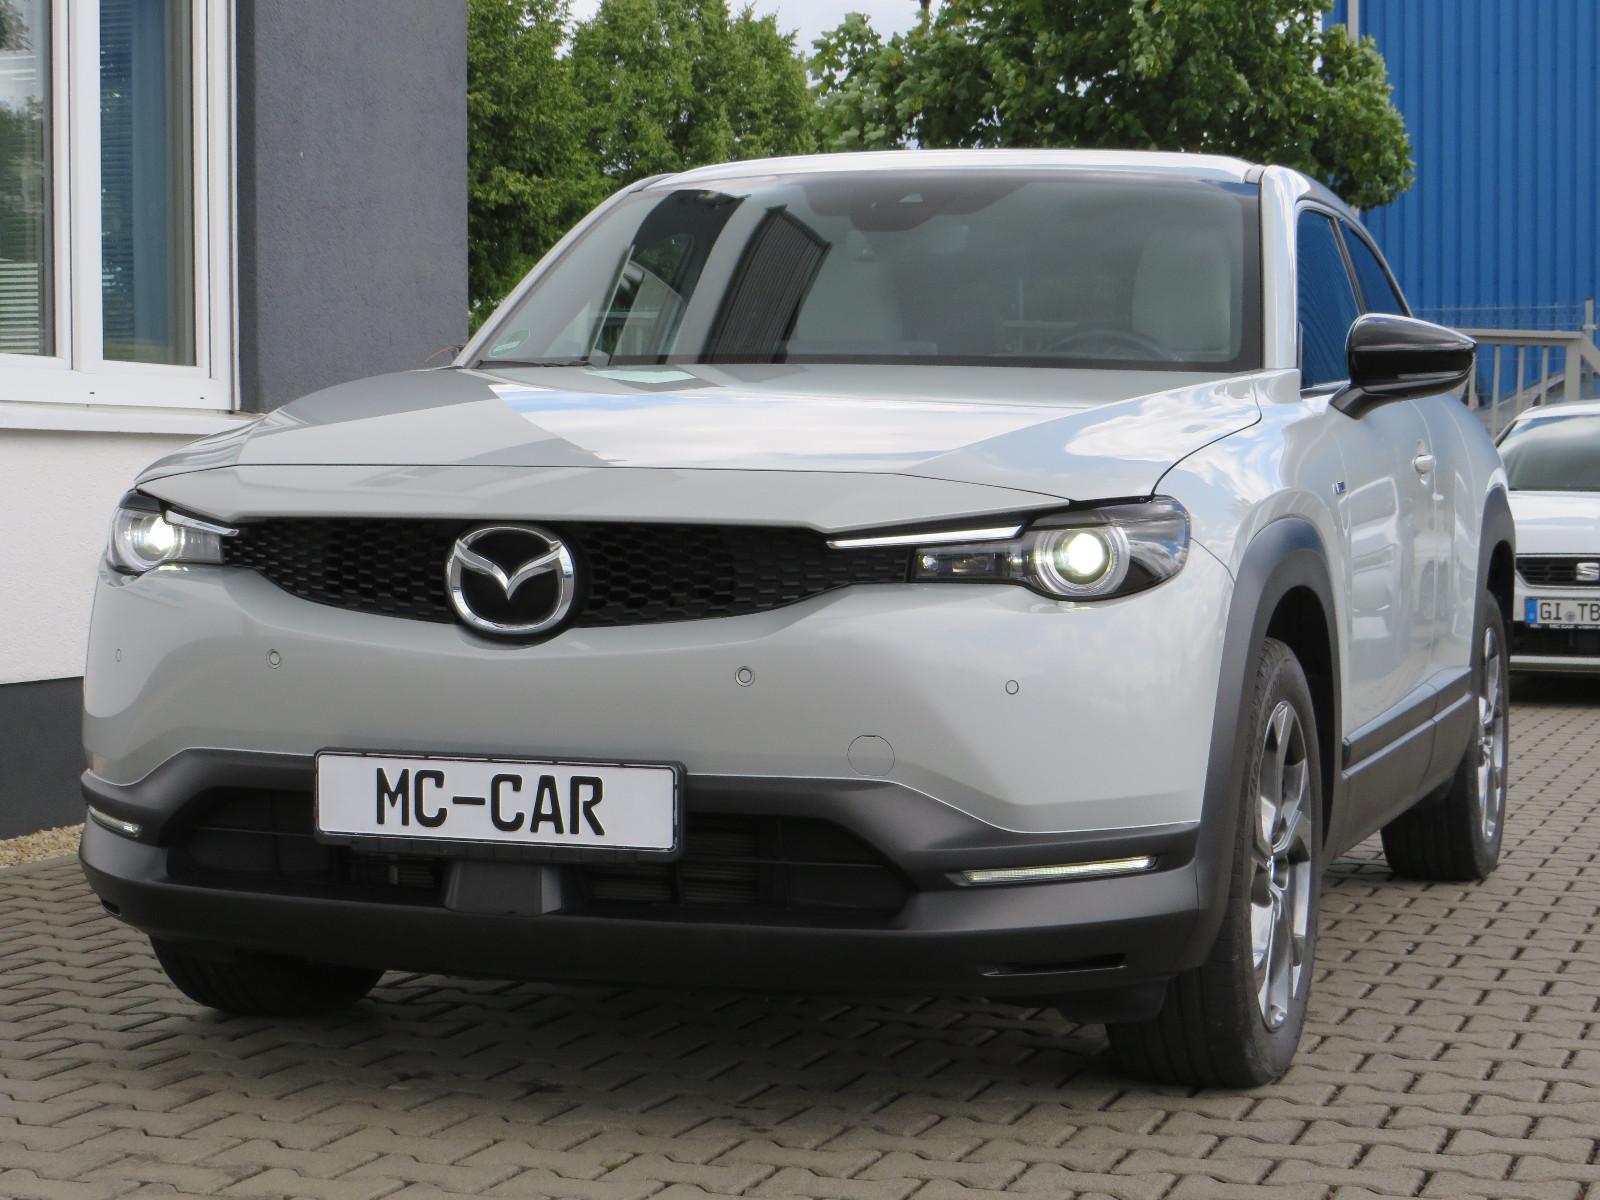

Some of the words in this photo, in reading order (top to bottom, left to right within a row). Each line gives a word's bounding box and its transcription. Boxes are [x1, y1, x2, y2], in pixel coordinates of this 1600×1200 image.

[1540, 602, 1563, 621] GI
[1577, 603, 1600, 622] TB
[376, 767, 605, 836] MC-CAR
